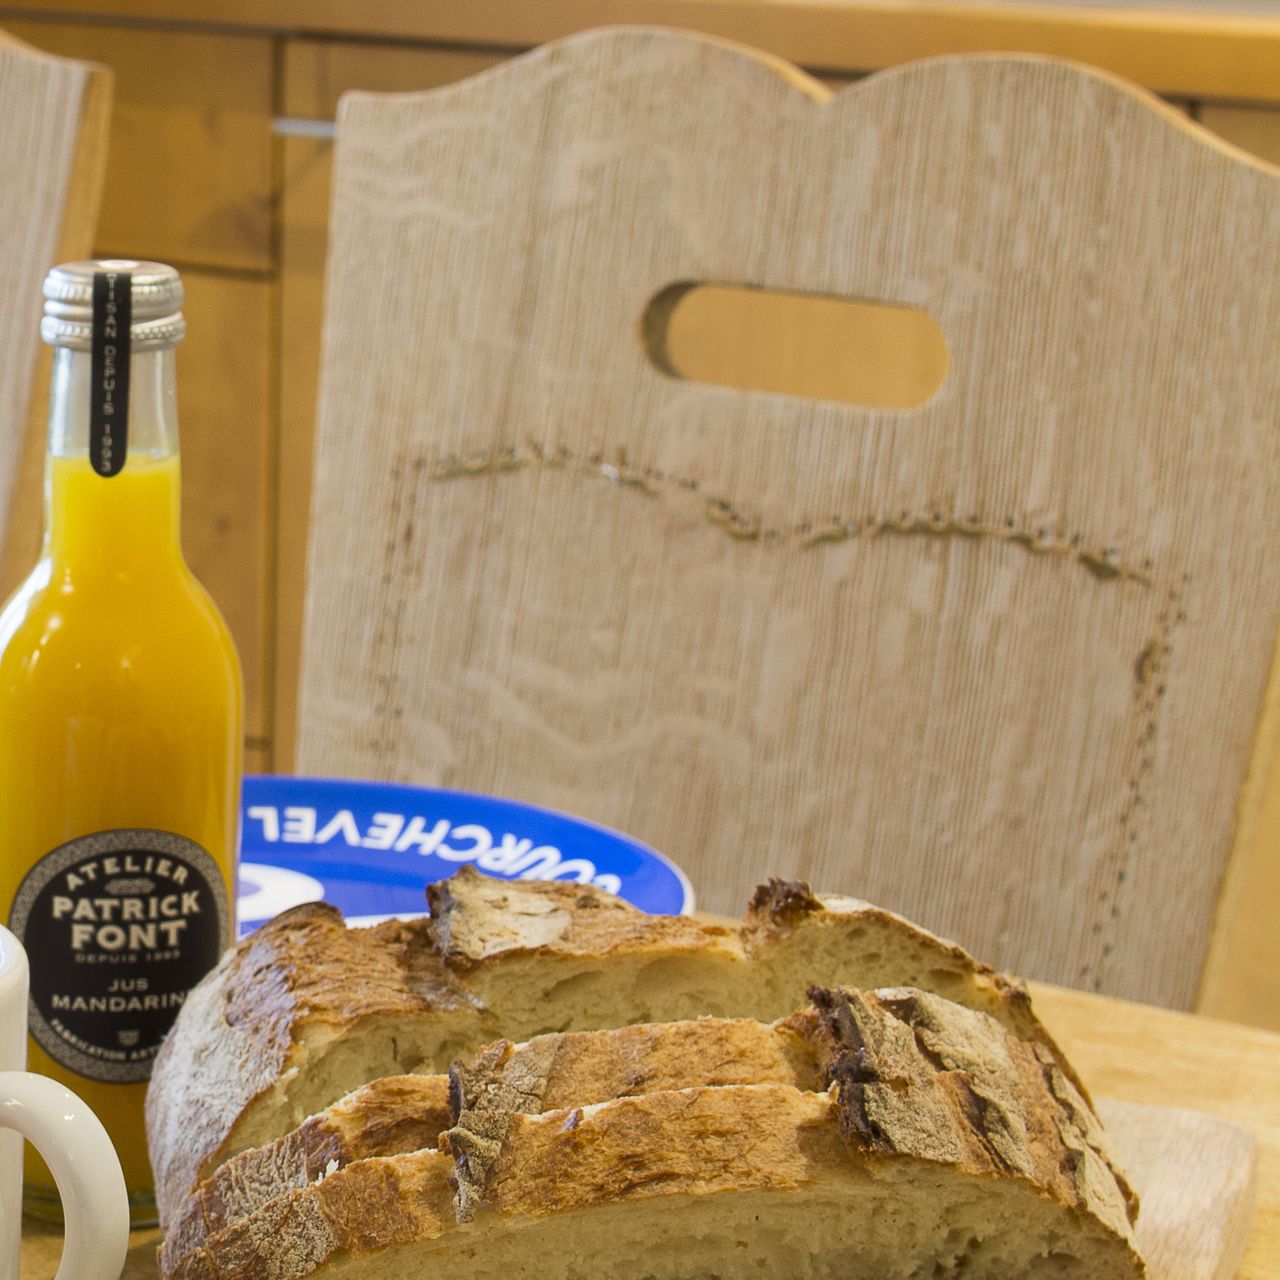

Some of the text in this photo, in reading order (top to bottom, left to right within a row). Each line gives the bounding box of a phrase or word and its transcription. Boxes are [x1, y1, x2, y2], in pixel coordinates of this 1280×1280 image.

[65, 855, 190, 892] ATELIER
[51, 889, 202, 920] PATRICK
[70, 919, 188, 952] FONT
[107, 977, 149, 993] JUS
[51, 990, 188, 1013] MANDARIN
